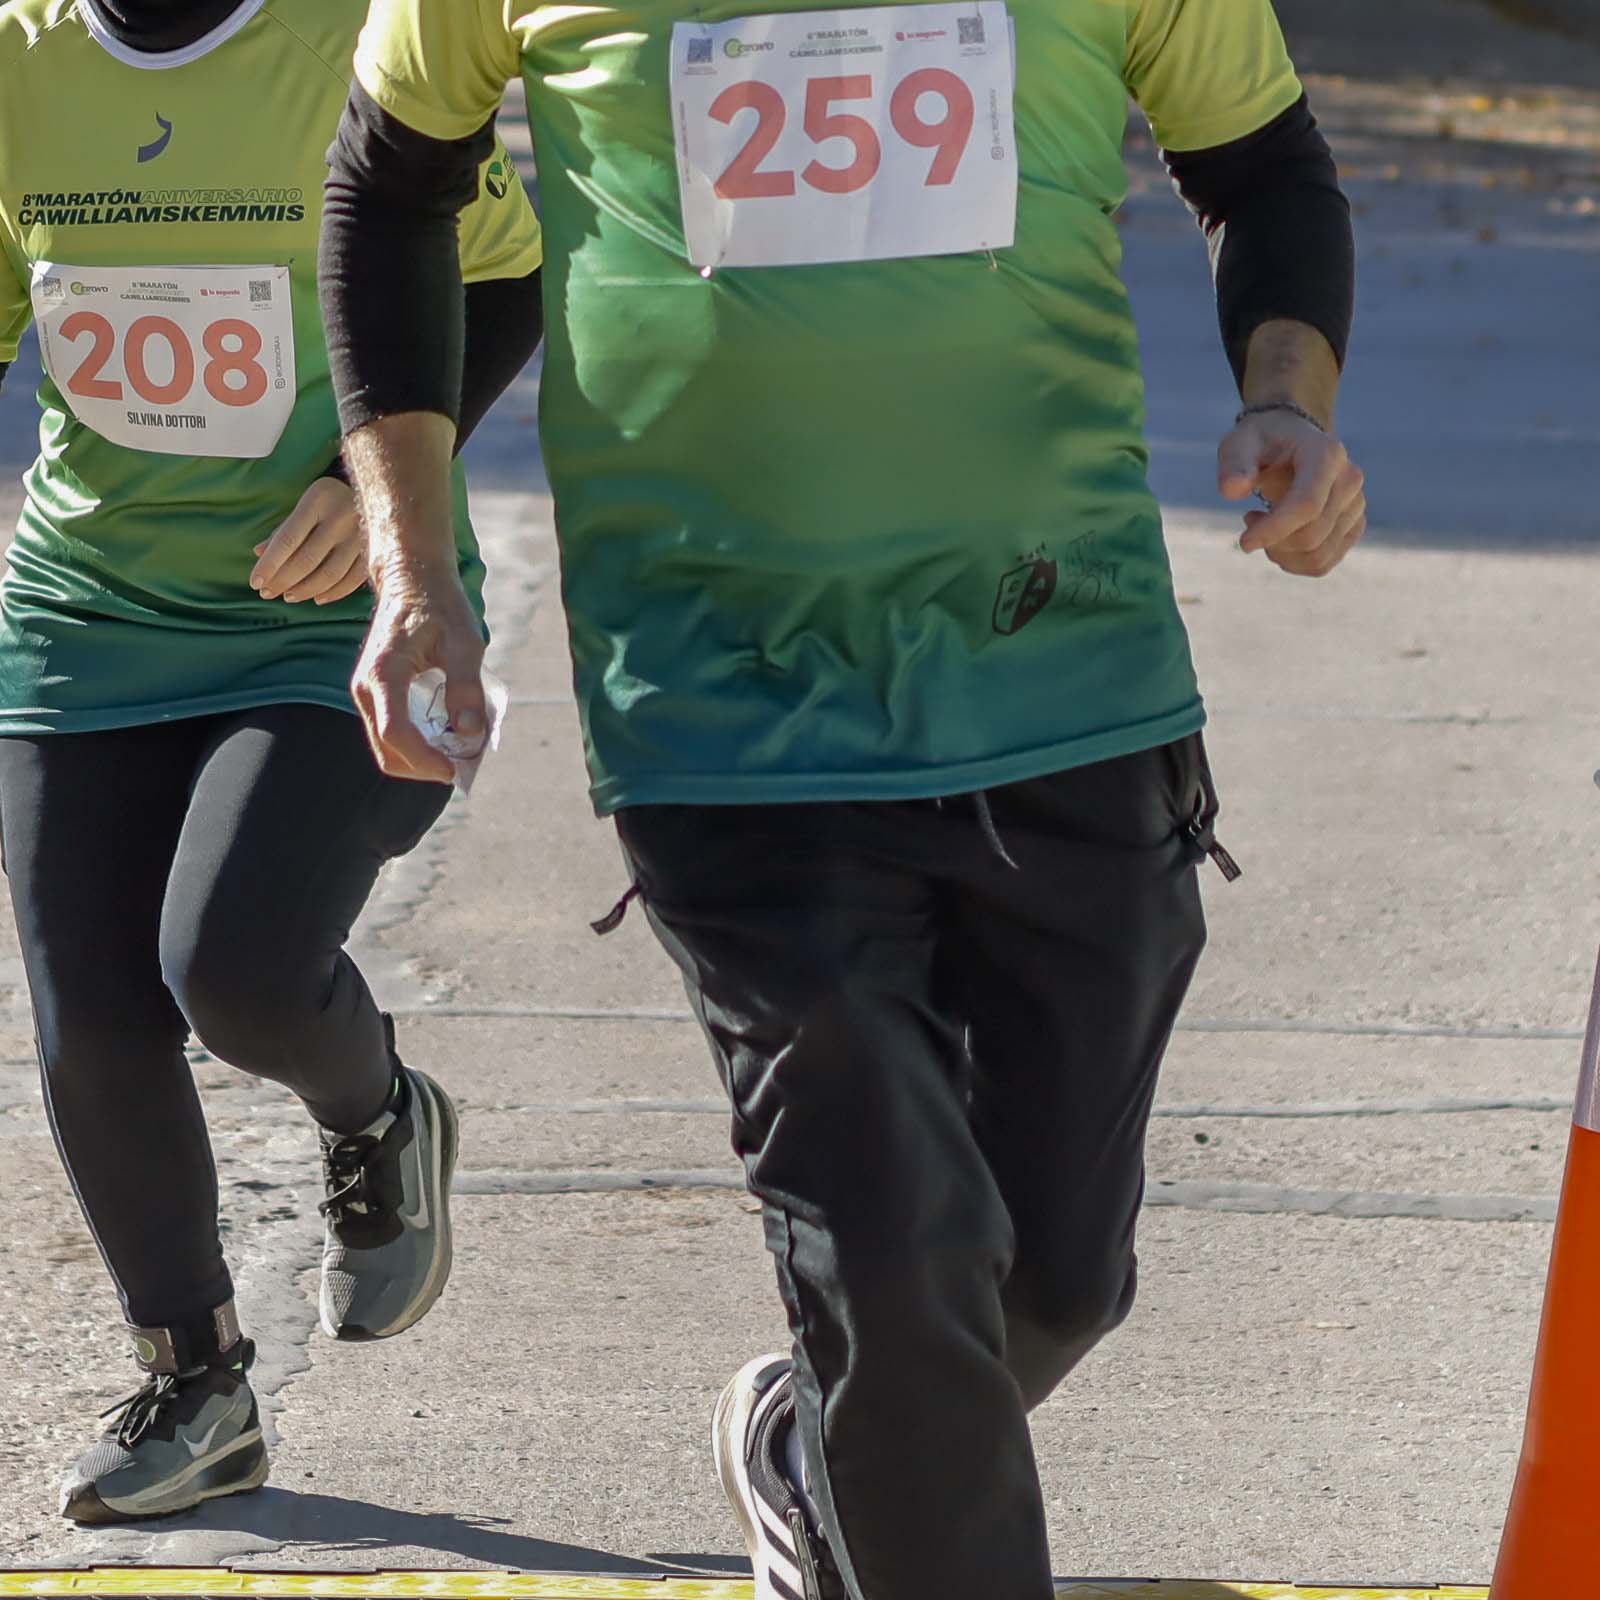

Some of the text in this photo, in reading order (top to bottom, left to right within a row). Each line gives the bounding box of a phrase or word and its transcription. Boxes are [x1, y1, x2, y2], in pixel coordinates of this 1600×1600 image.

[707, 67, 975, 200] 259
[18, 204, 305, 225] CAWILLIAMSKEMMIS
[57, 311, 268, 407] 208
[127, 411, 206, 429] SILVINA DOTTORI
